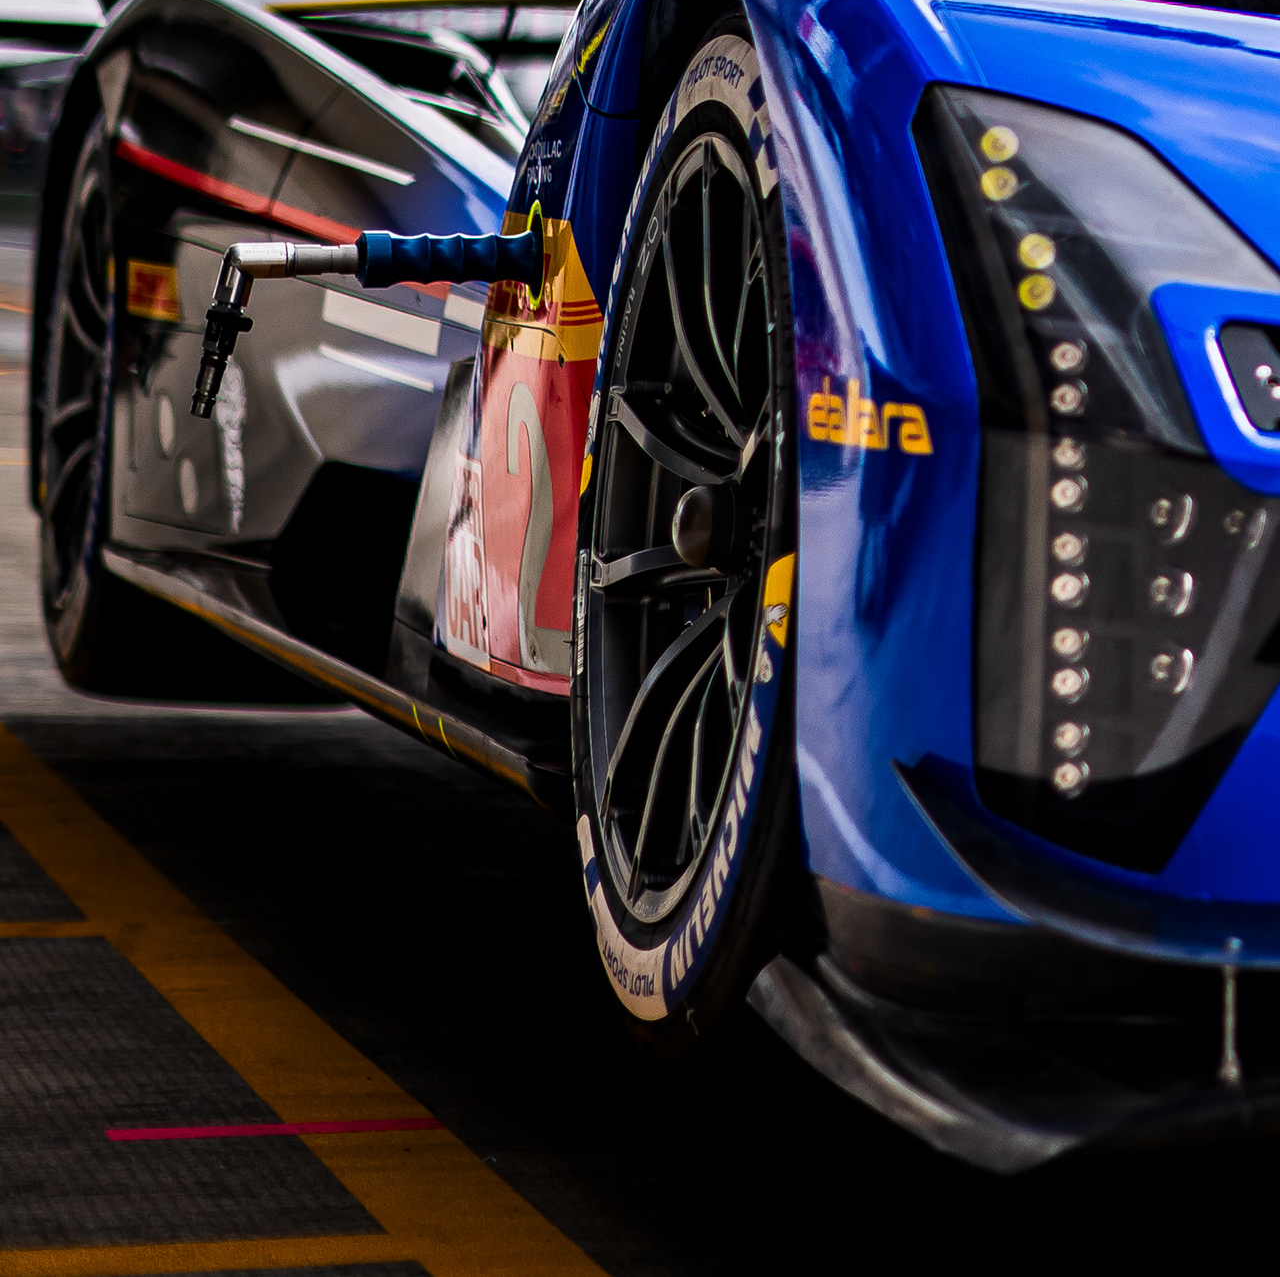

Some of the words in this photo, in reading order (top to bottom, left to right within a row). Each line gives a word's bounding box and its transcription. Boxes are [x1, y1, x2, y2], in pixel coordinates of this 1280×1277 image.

[684, 56, 715, 93] PILOT
[713, 55, 745, 89] SPORT
[507, 381, 571, 678] 2
[602, 940, 629, 989] SPORT
[629, 972, 655, 998] PILOT
